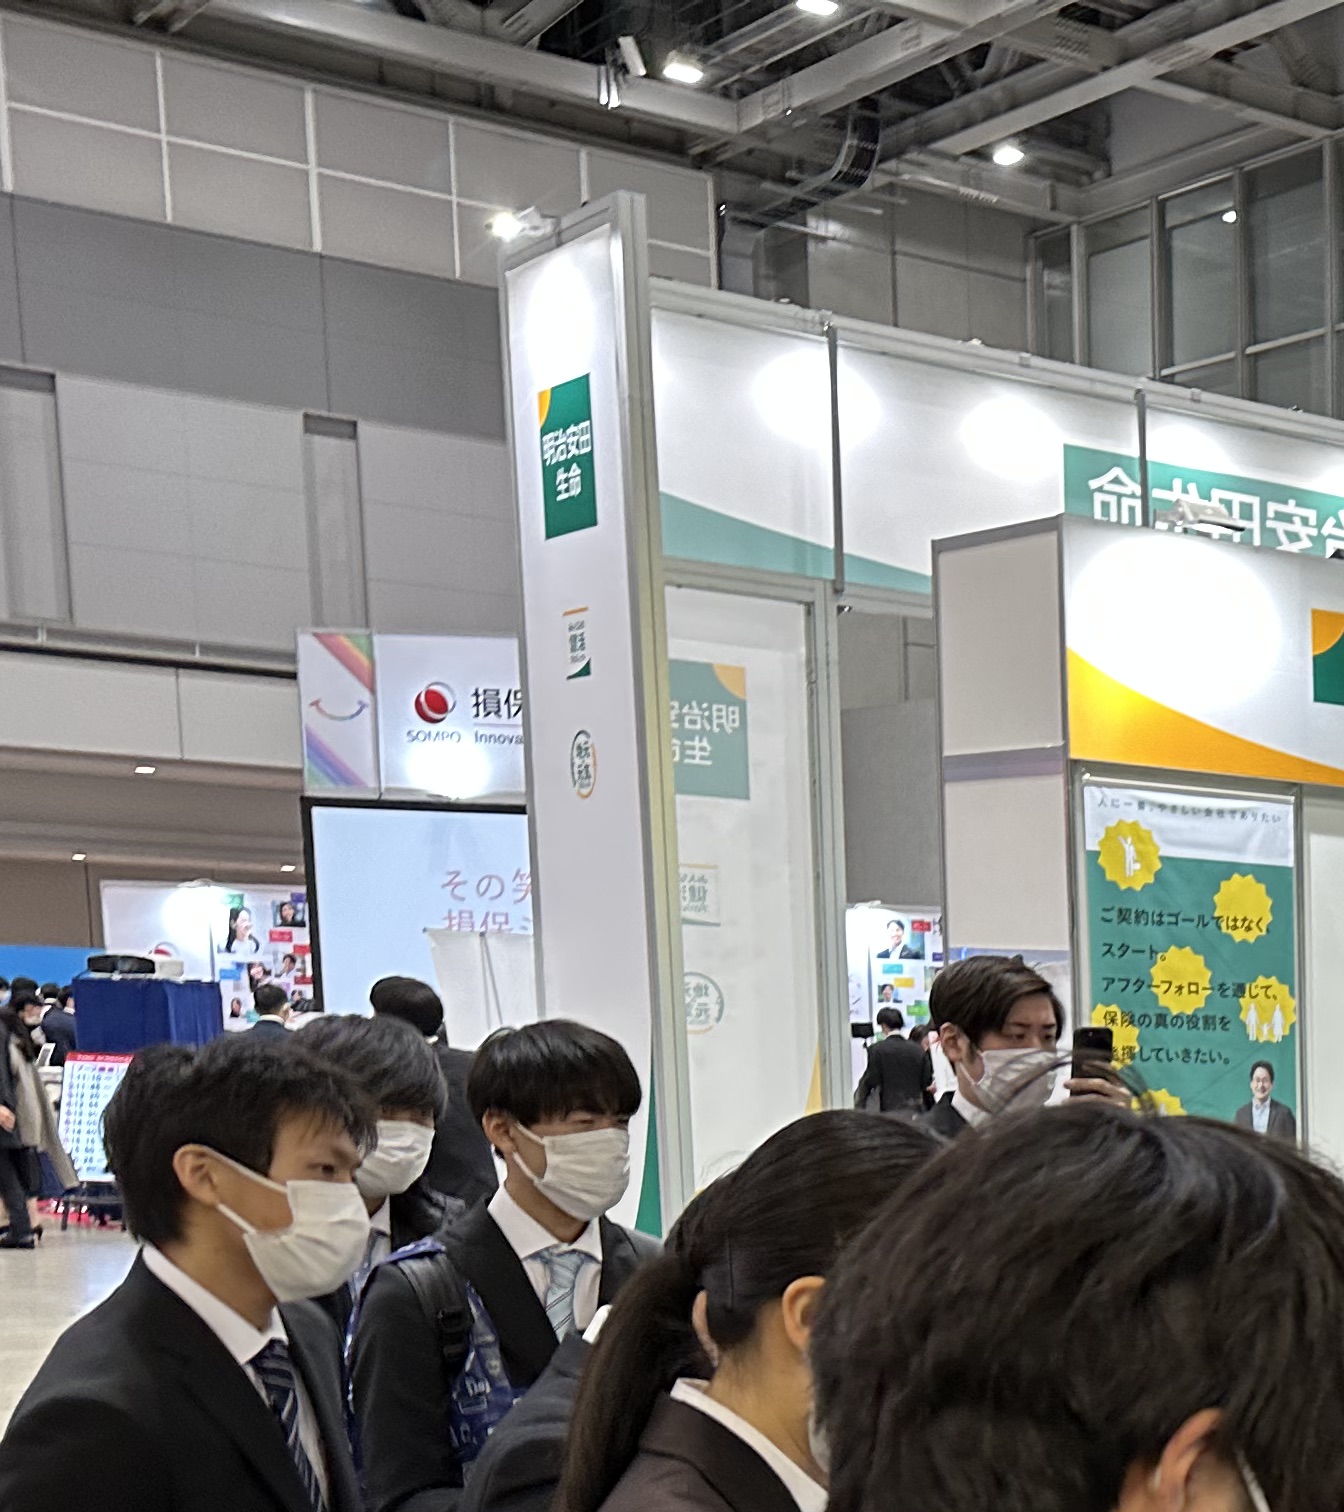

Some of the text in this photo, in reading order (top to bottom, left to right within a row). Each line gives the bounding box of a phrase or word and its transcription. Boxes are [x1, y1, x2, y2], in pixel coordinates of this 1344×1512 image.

[542, 420, 591, 467] 明治安田
[556, 462, 581, 501] 生命
[1102, 943, 1166, 961] スタート。
[1102, 977, 1278, 1001] アフターフォローを通じて、
[1104, 1010, 1231, 1031] 保険の真の役割を
